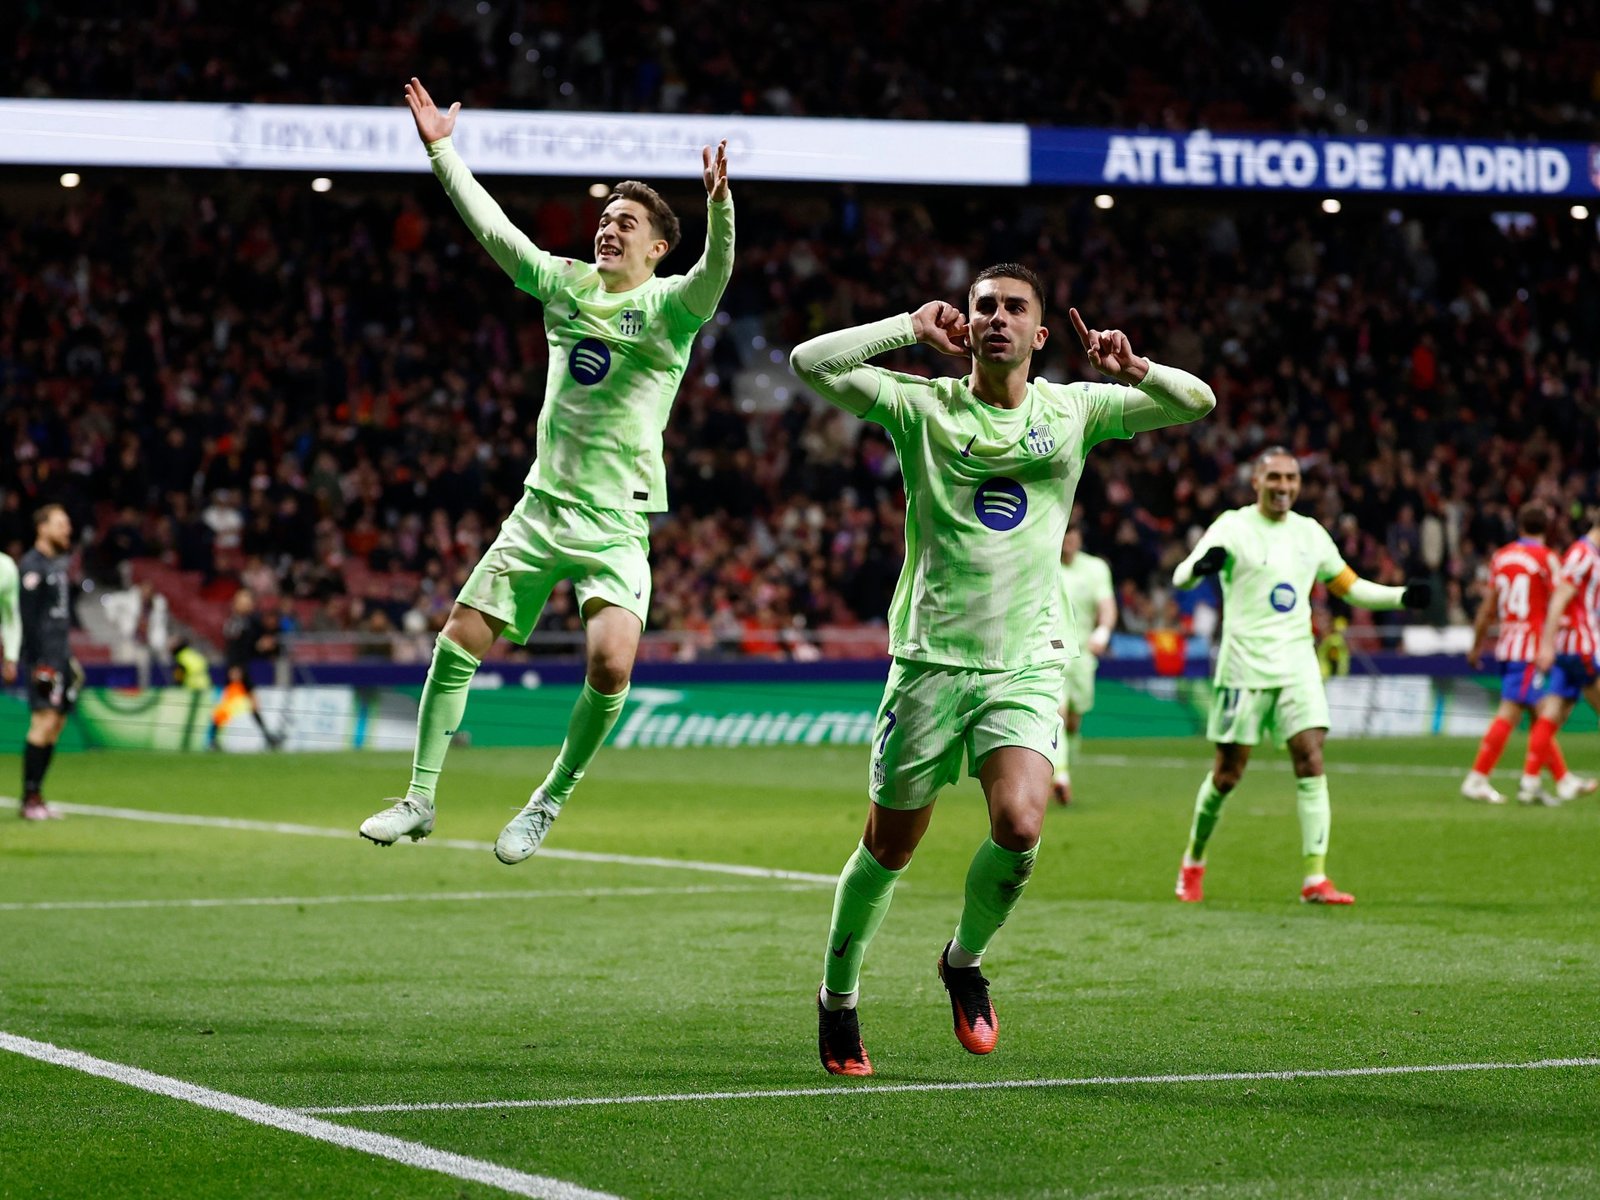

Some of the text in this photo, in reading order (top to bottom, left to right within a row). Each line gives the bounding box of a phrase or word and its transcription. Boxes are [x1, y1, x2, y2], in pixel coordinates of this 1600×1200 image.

[1102, 128, 1571, 193] ATLÉTICO DE MADRID
[879, 709, 897, 755] 7
